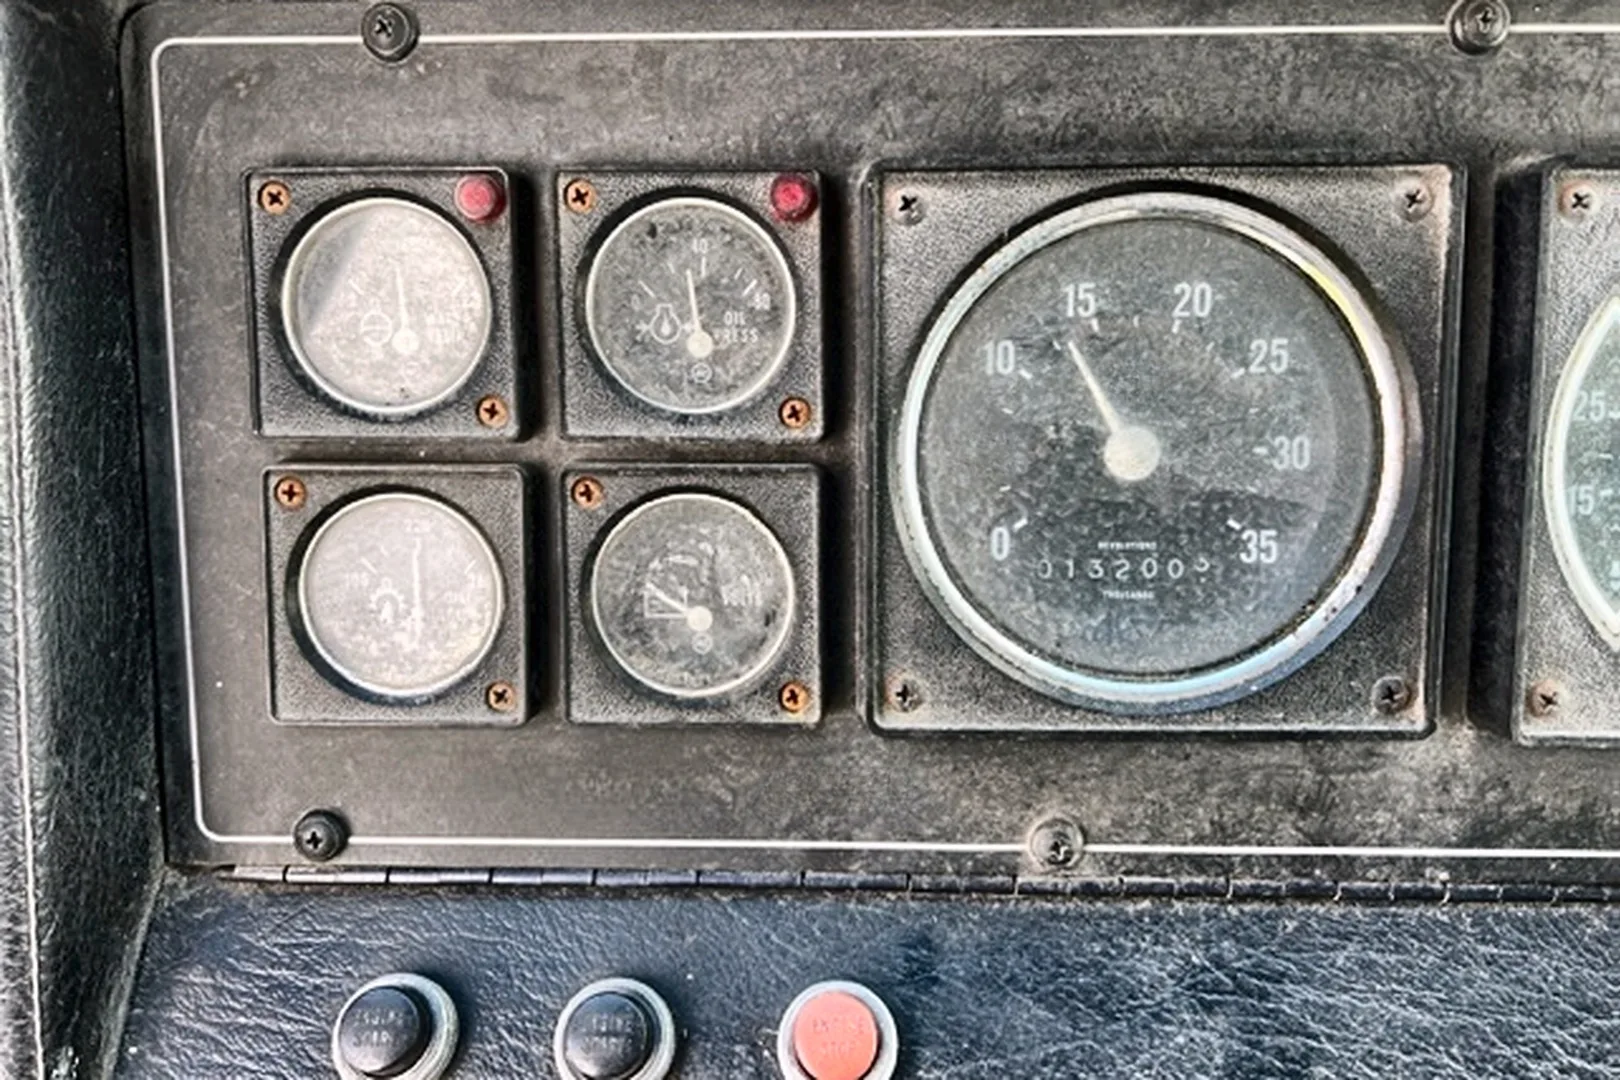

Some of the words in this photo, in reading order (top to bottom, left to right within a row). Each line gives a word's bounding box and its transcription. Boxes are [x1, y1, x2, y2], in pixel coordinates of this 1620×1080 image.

[1063, 282, 1098, 319] 15
[1172, 282, 1213, 319] 20
[984, 339, 1016, 376] 10
[1248, 338, 1290, 374] 25
[1573, 391, 1607, 423] 25
[1271, 436, 1311, 471] 30
[990, 527, 1011, 561] 0
[1239, 529, 1279, 564] 35
